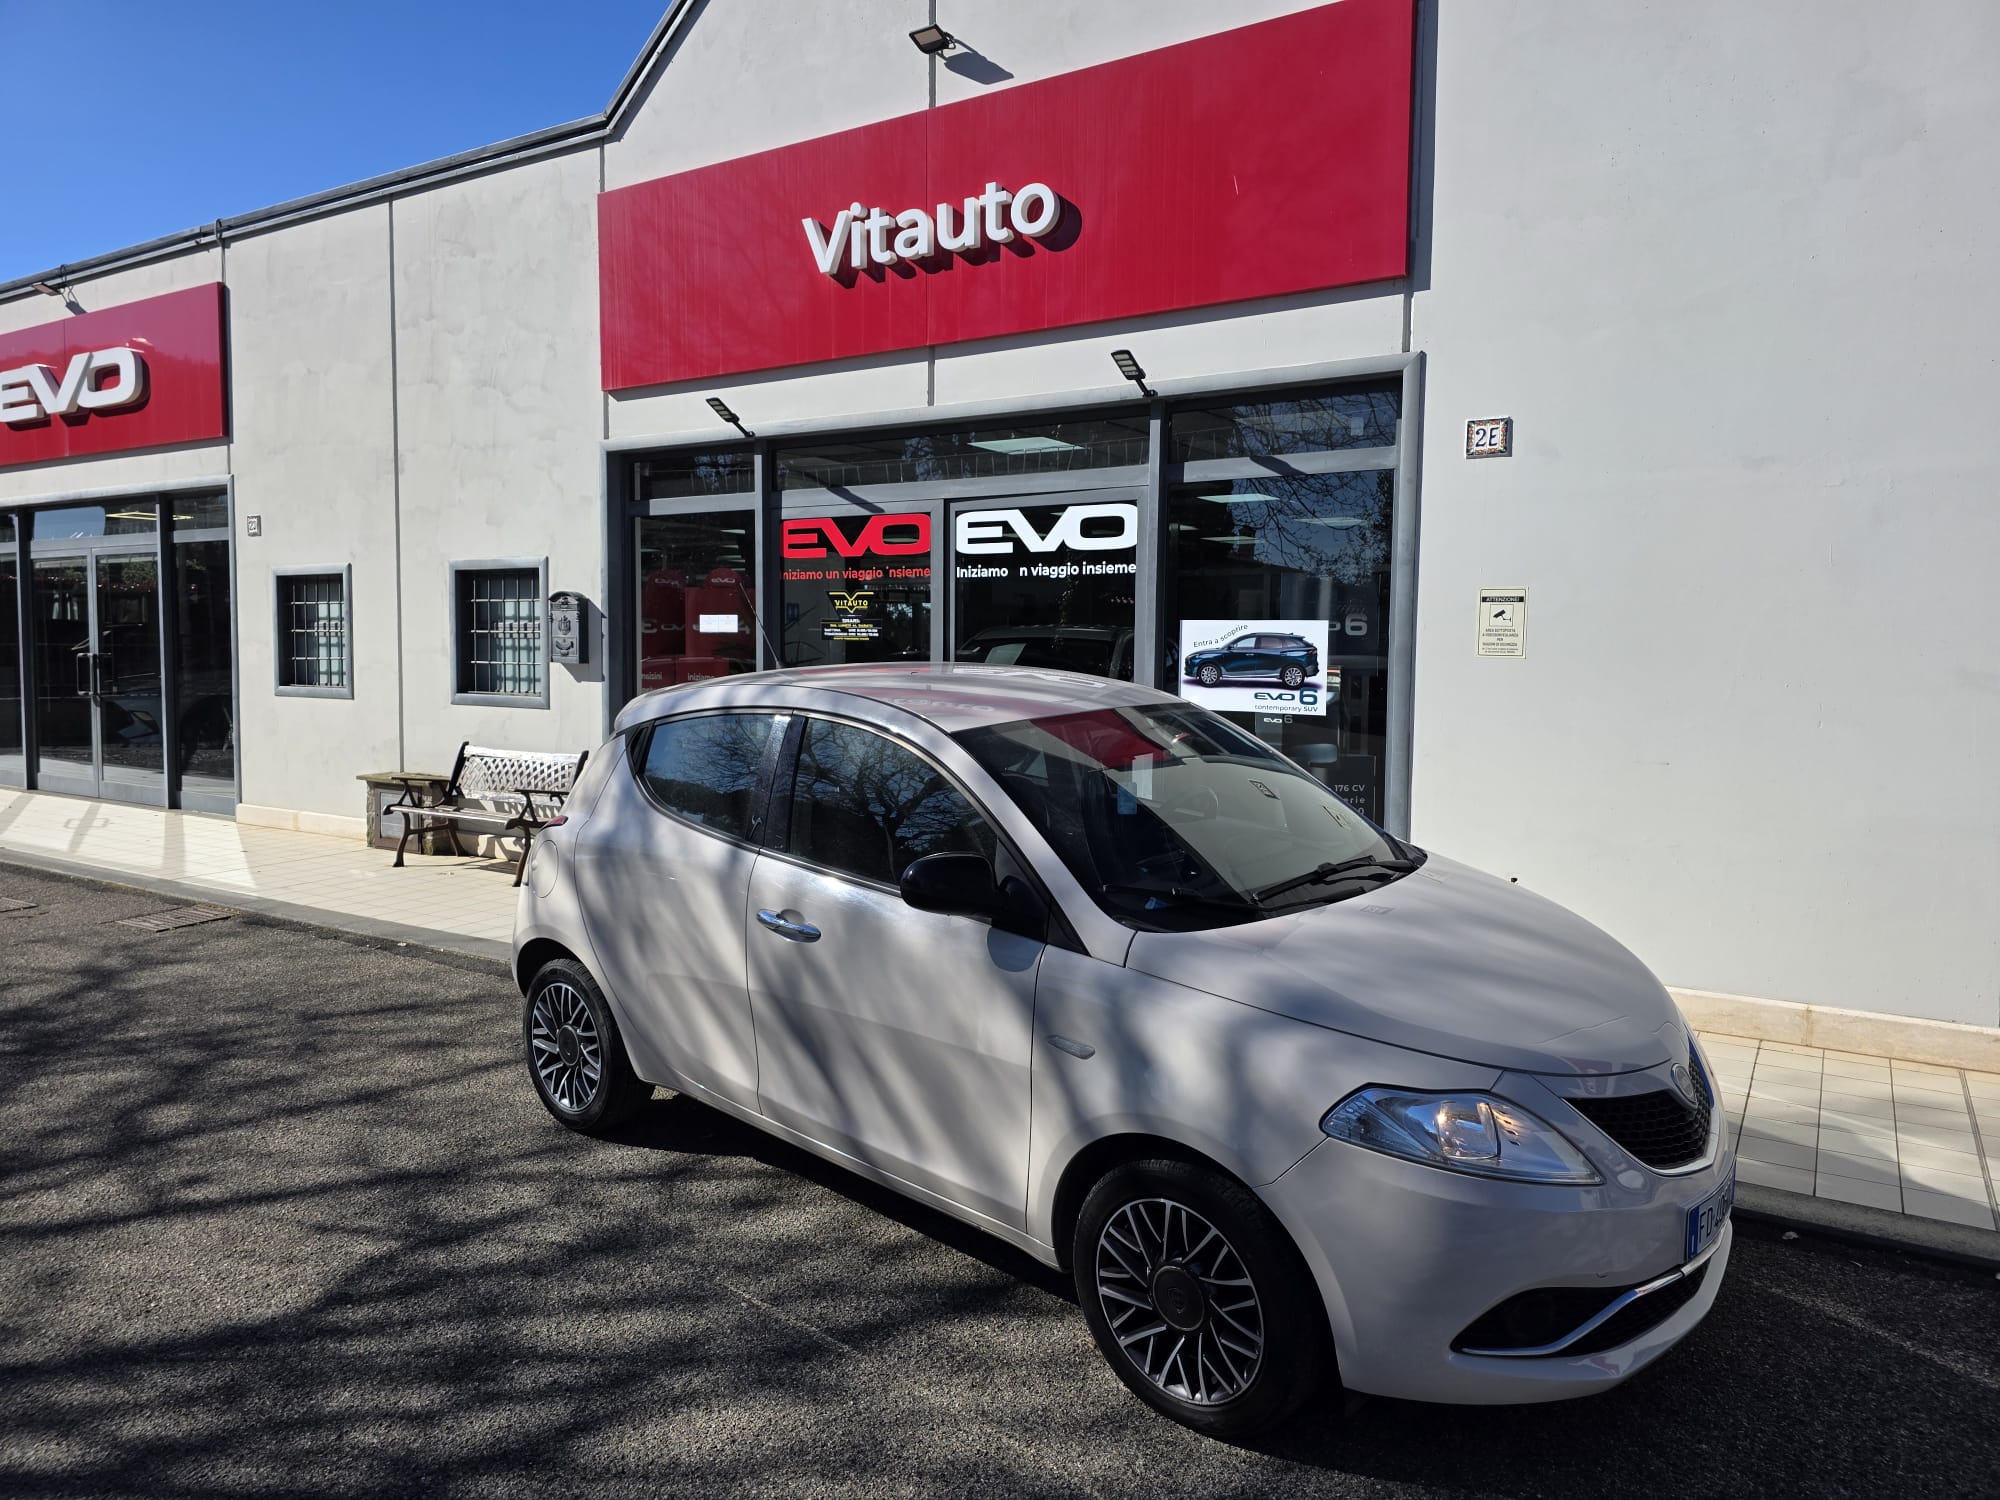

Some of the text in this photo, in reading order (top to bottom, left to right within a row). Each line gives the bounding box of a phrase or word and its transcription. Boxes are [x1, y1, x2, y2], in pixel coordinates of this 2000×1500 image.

[801, 181, 1060, 276] Vitauto
[0, 346, 143, 424] EVO
[1475, 426, 1500, 448] 2E
[780, 513, 931, 559] EVO
[956, 503, 1138, 555] EVO
[780, 566, 931, 582] niziamo un viaggio nsieme
[956, 564, 1009, 579] Iniziamo
[1031, 562, 1079, 579] viaggio
[1082, 561, 1137, 576] insieme
[834, 599, 869, 607] VITAUTO
[1193, 639, 1213, 648] Entra
[1220, 624, 1249, 642] scoprire
[1253, 687, 1319, 706] EVO 6
[1254, 704, 1302, 713] contemporary
[1334, 784, 1366, 792] 176 CV
